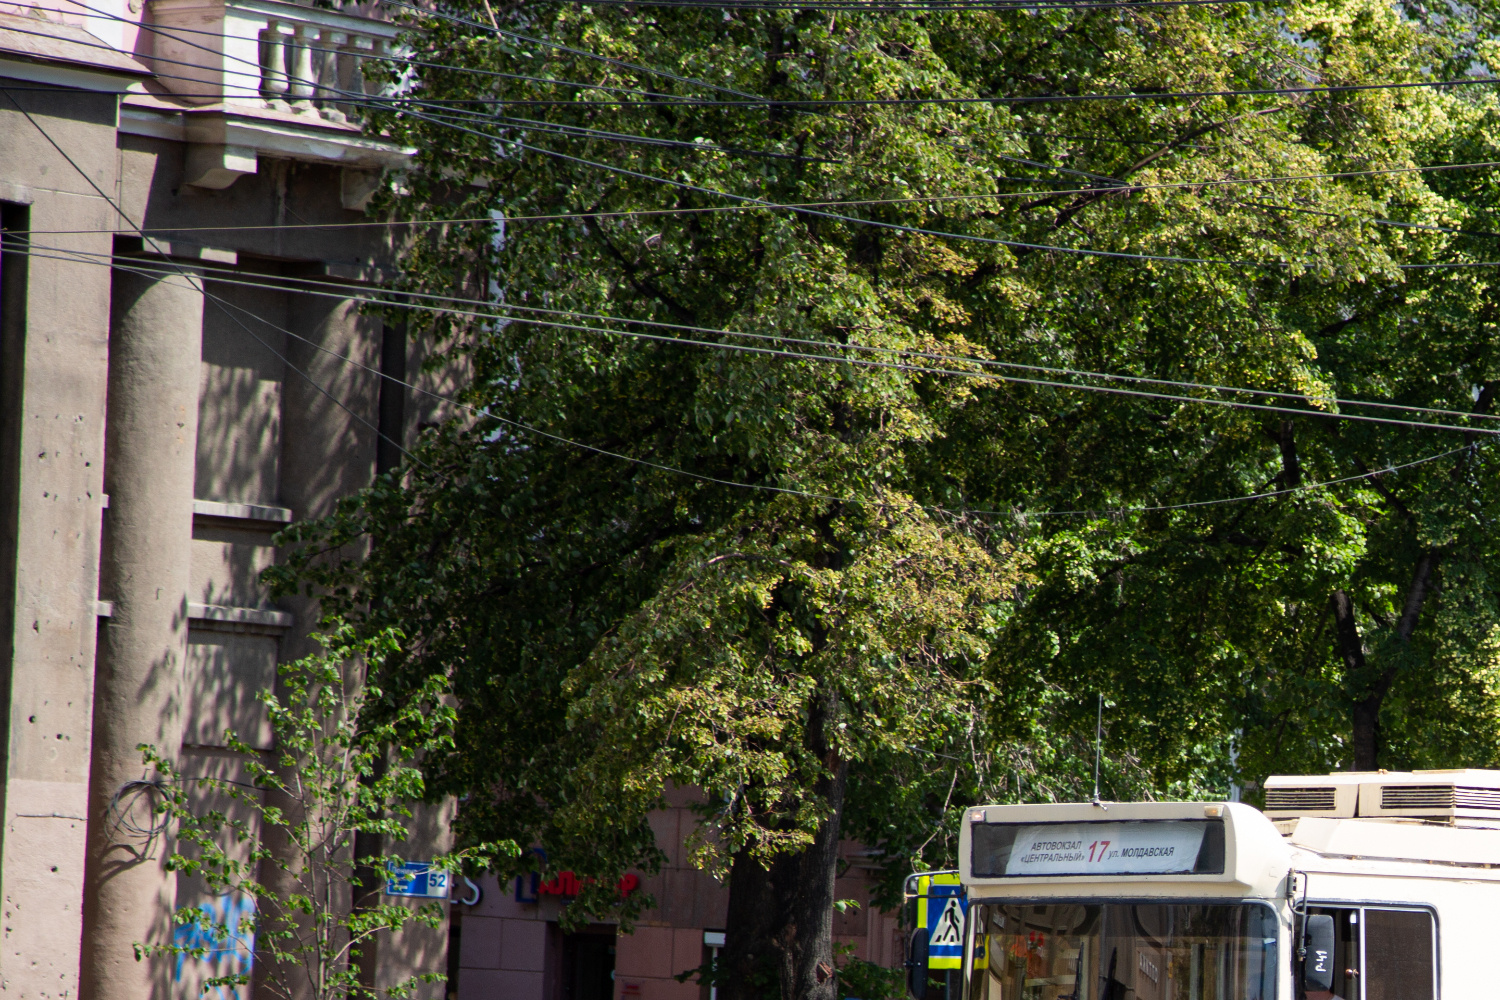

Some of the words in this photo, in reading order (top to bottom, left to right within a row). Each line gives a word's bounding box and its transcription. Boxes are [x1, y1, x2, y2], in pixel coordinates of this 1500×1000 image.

[1031, 841, 1082, 851] АВТОВОКЗАЛ
[1088, 840, 1111, 863] 17
[1108, 849, 1119, 860] ул.
[1120, 847, 1175, 858] МОЛДАВСКАЯ
[1020, 850, 1085, 863] «ЦЕНТРАЛЬНЫЙ»
[429, 873, 446, 888] 52
